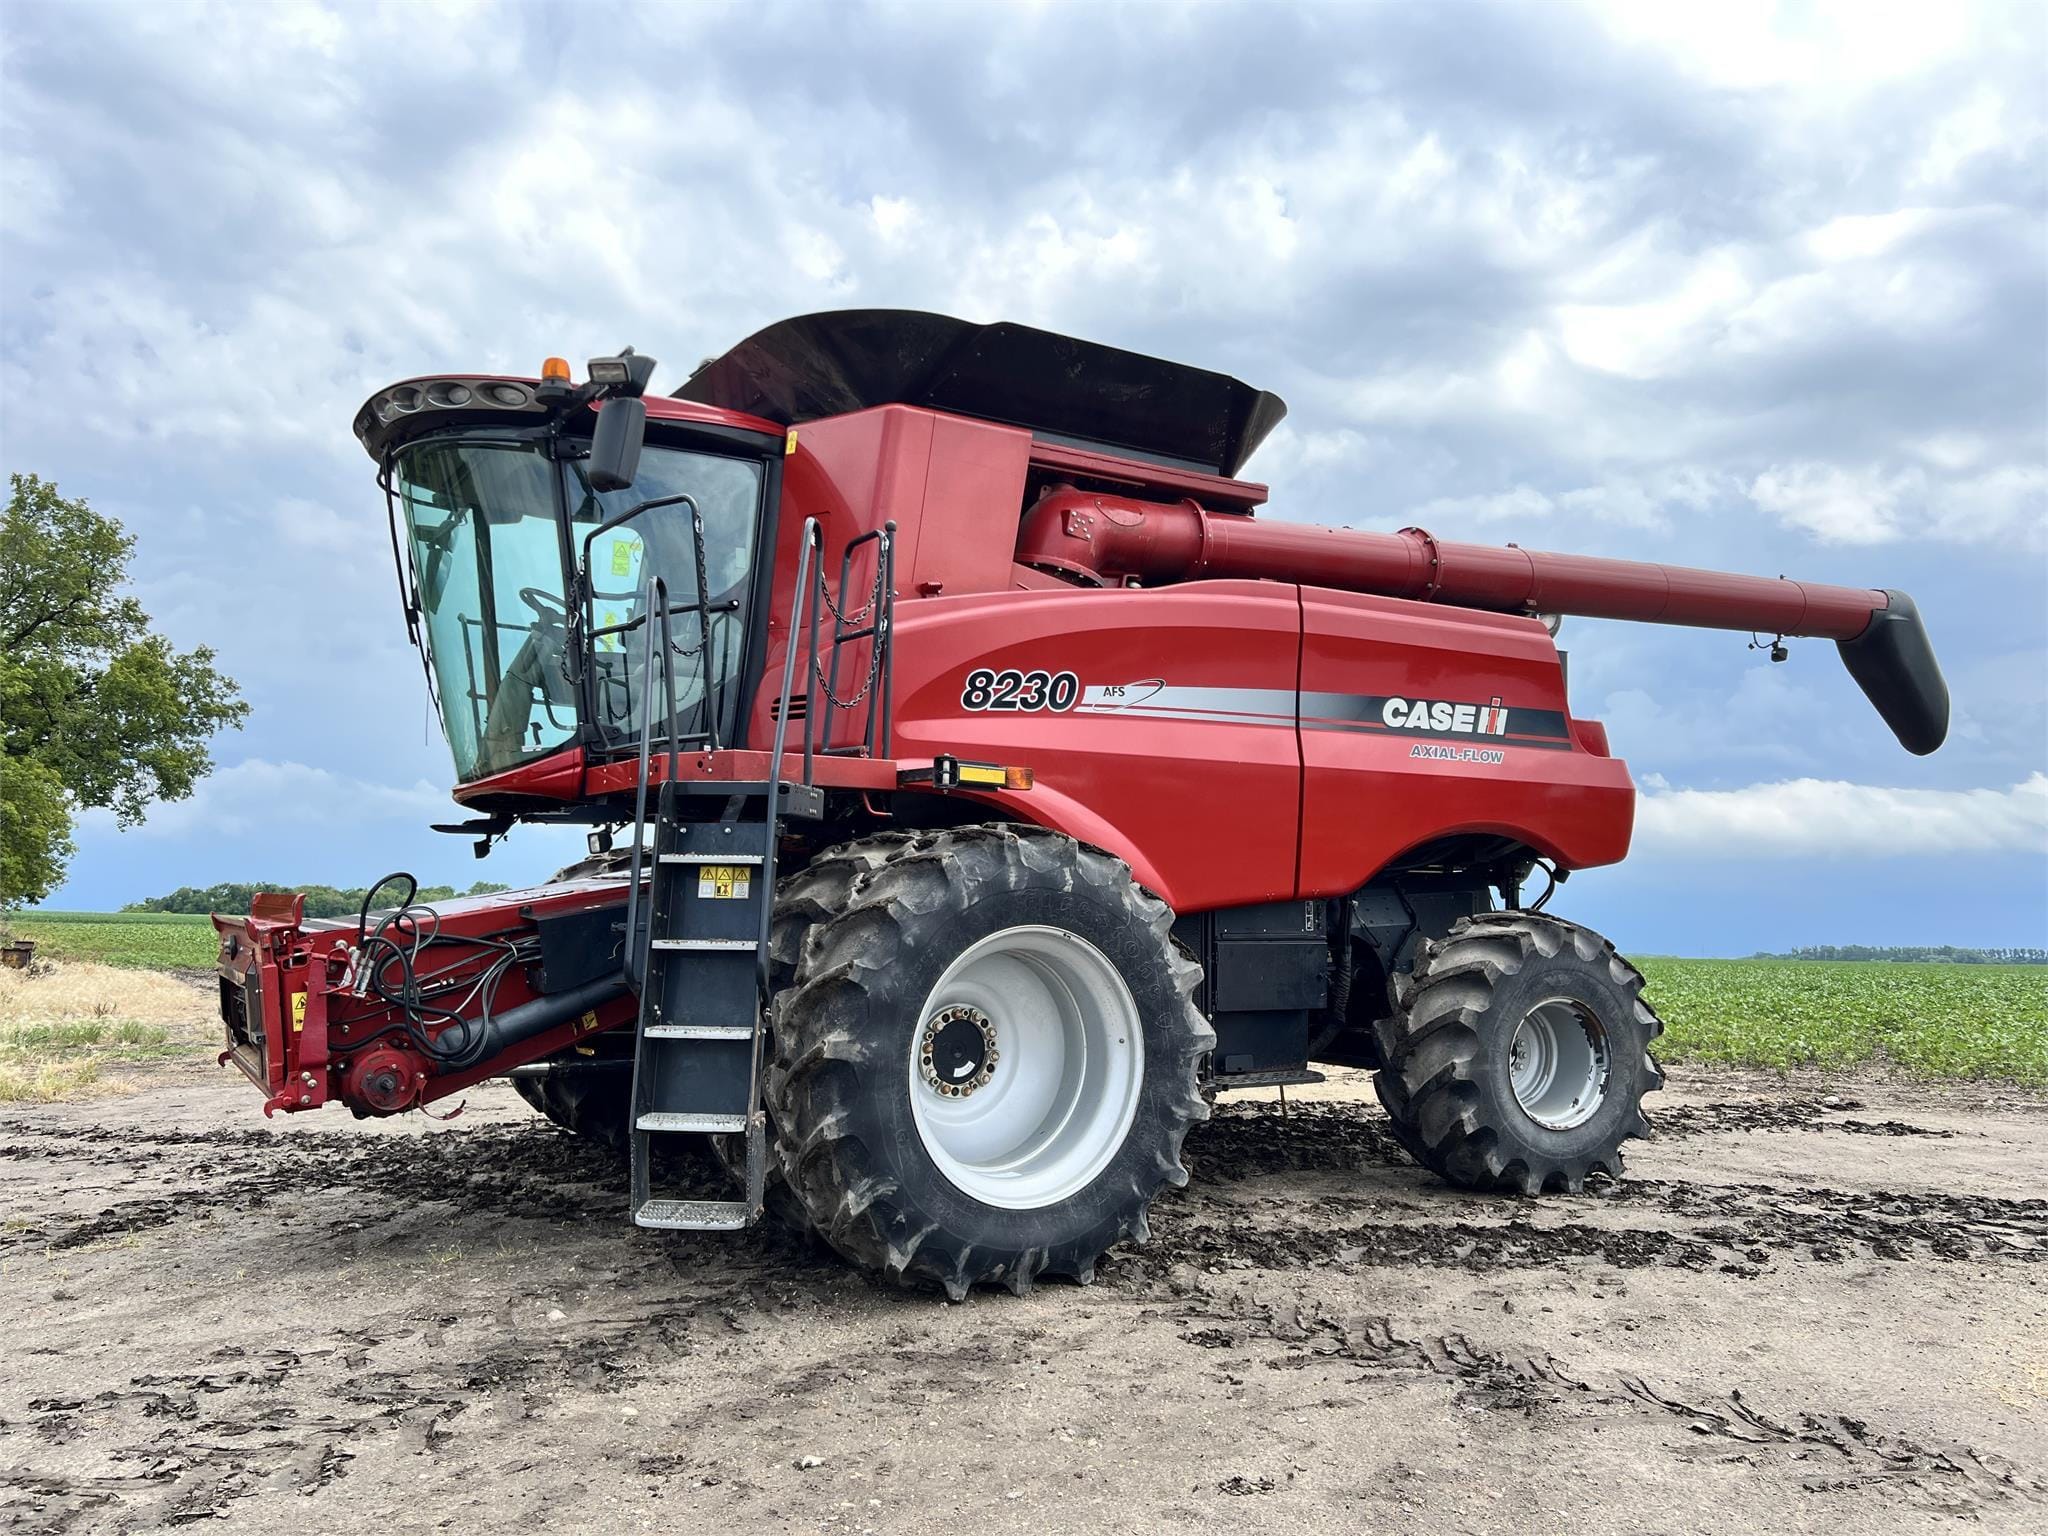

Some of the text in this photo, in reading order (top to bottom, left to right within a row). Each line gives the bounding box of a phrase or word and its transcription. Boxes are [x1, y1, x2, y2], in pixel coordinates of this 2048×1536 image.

[961, 668, 1079, 713] 8230
[1103, 686, 1125, 697] AFS
[1382, 697, 1476, 733] CASE
[1410, 744, 1504, 765] AXIAL-FLOW
